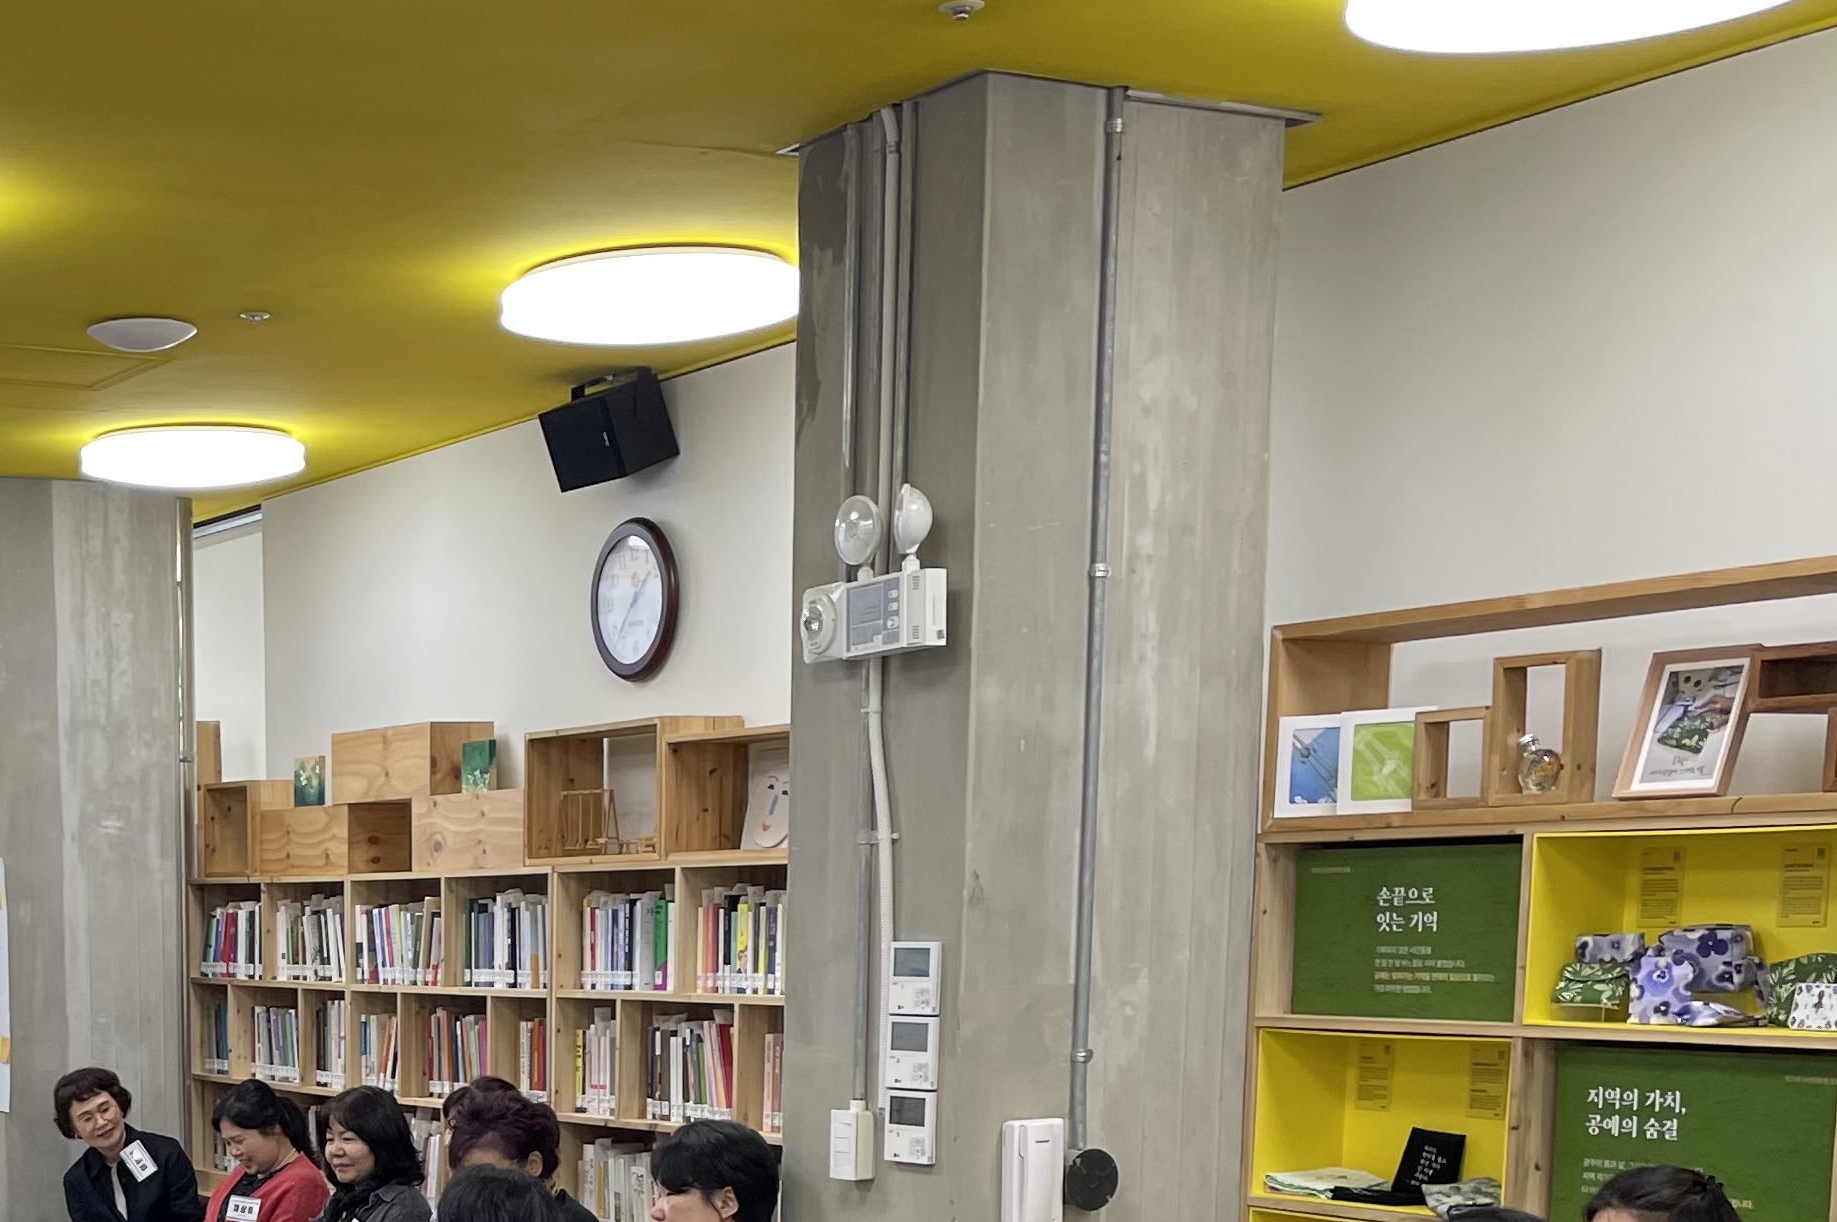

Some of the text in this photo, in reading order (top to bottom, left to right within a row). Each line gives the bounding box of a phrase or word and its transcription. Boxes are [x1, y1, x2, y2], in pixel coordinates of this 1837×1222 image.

[1376, 886, 1436, 907] 손끝으로
[1376, 911, 1438, 932] 잇는 기억
[1587, 1086, 1686, 1115] 지역의 가치,
[1585, 1113, 1678, 1141] 공예의 숨결
